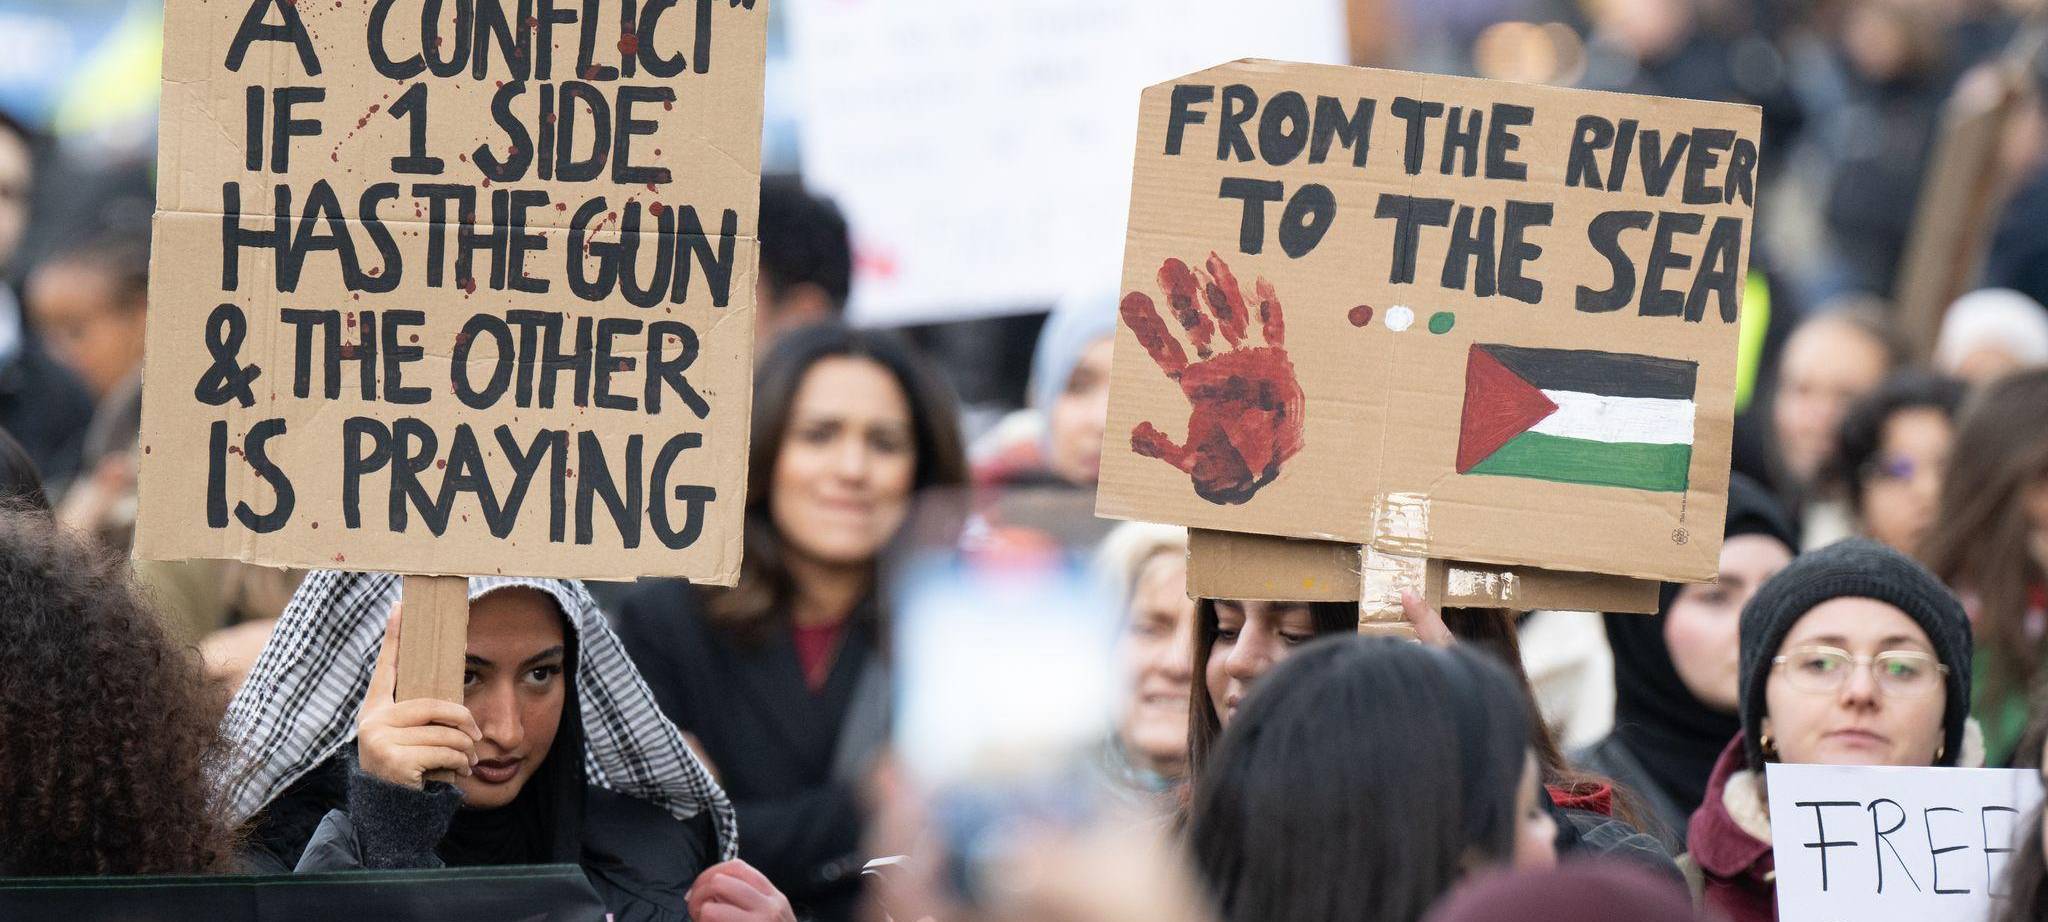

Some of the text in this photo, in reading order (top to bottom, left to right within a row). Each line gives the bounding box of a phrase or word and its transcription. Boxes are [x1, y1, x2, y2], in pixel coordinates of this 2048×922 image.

[224, 0, 322, 76] A
[245, 80, 677, 184] IF 1 SIDE
[1163, 84, 1757, 208] FROM THE RIVER
[221, 178, 738, 308] HAS THE GUN
[1218, 176, 1743, 323] TO THE SEA
[194, 303, 711, 419] & THE OTHER
[206, 416, 717, 550] IS PRAYING
[1795, 798, 2020, 898] FREE
